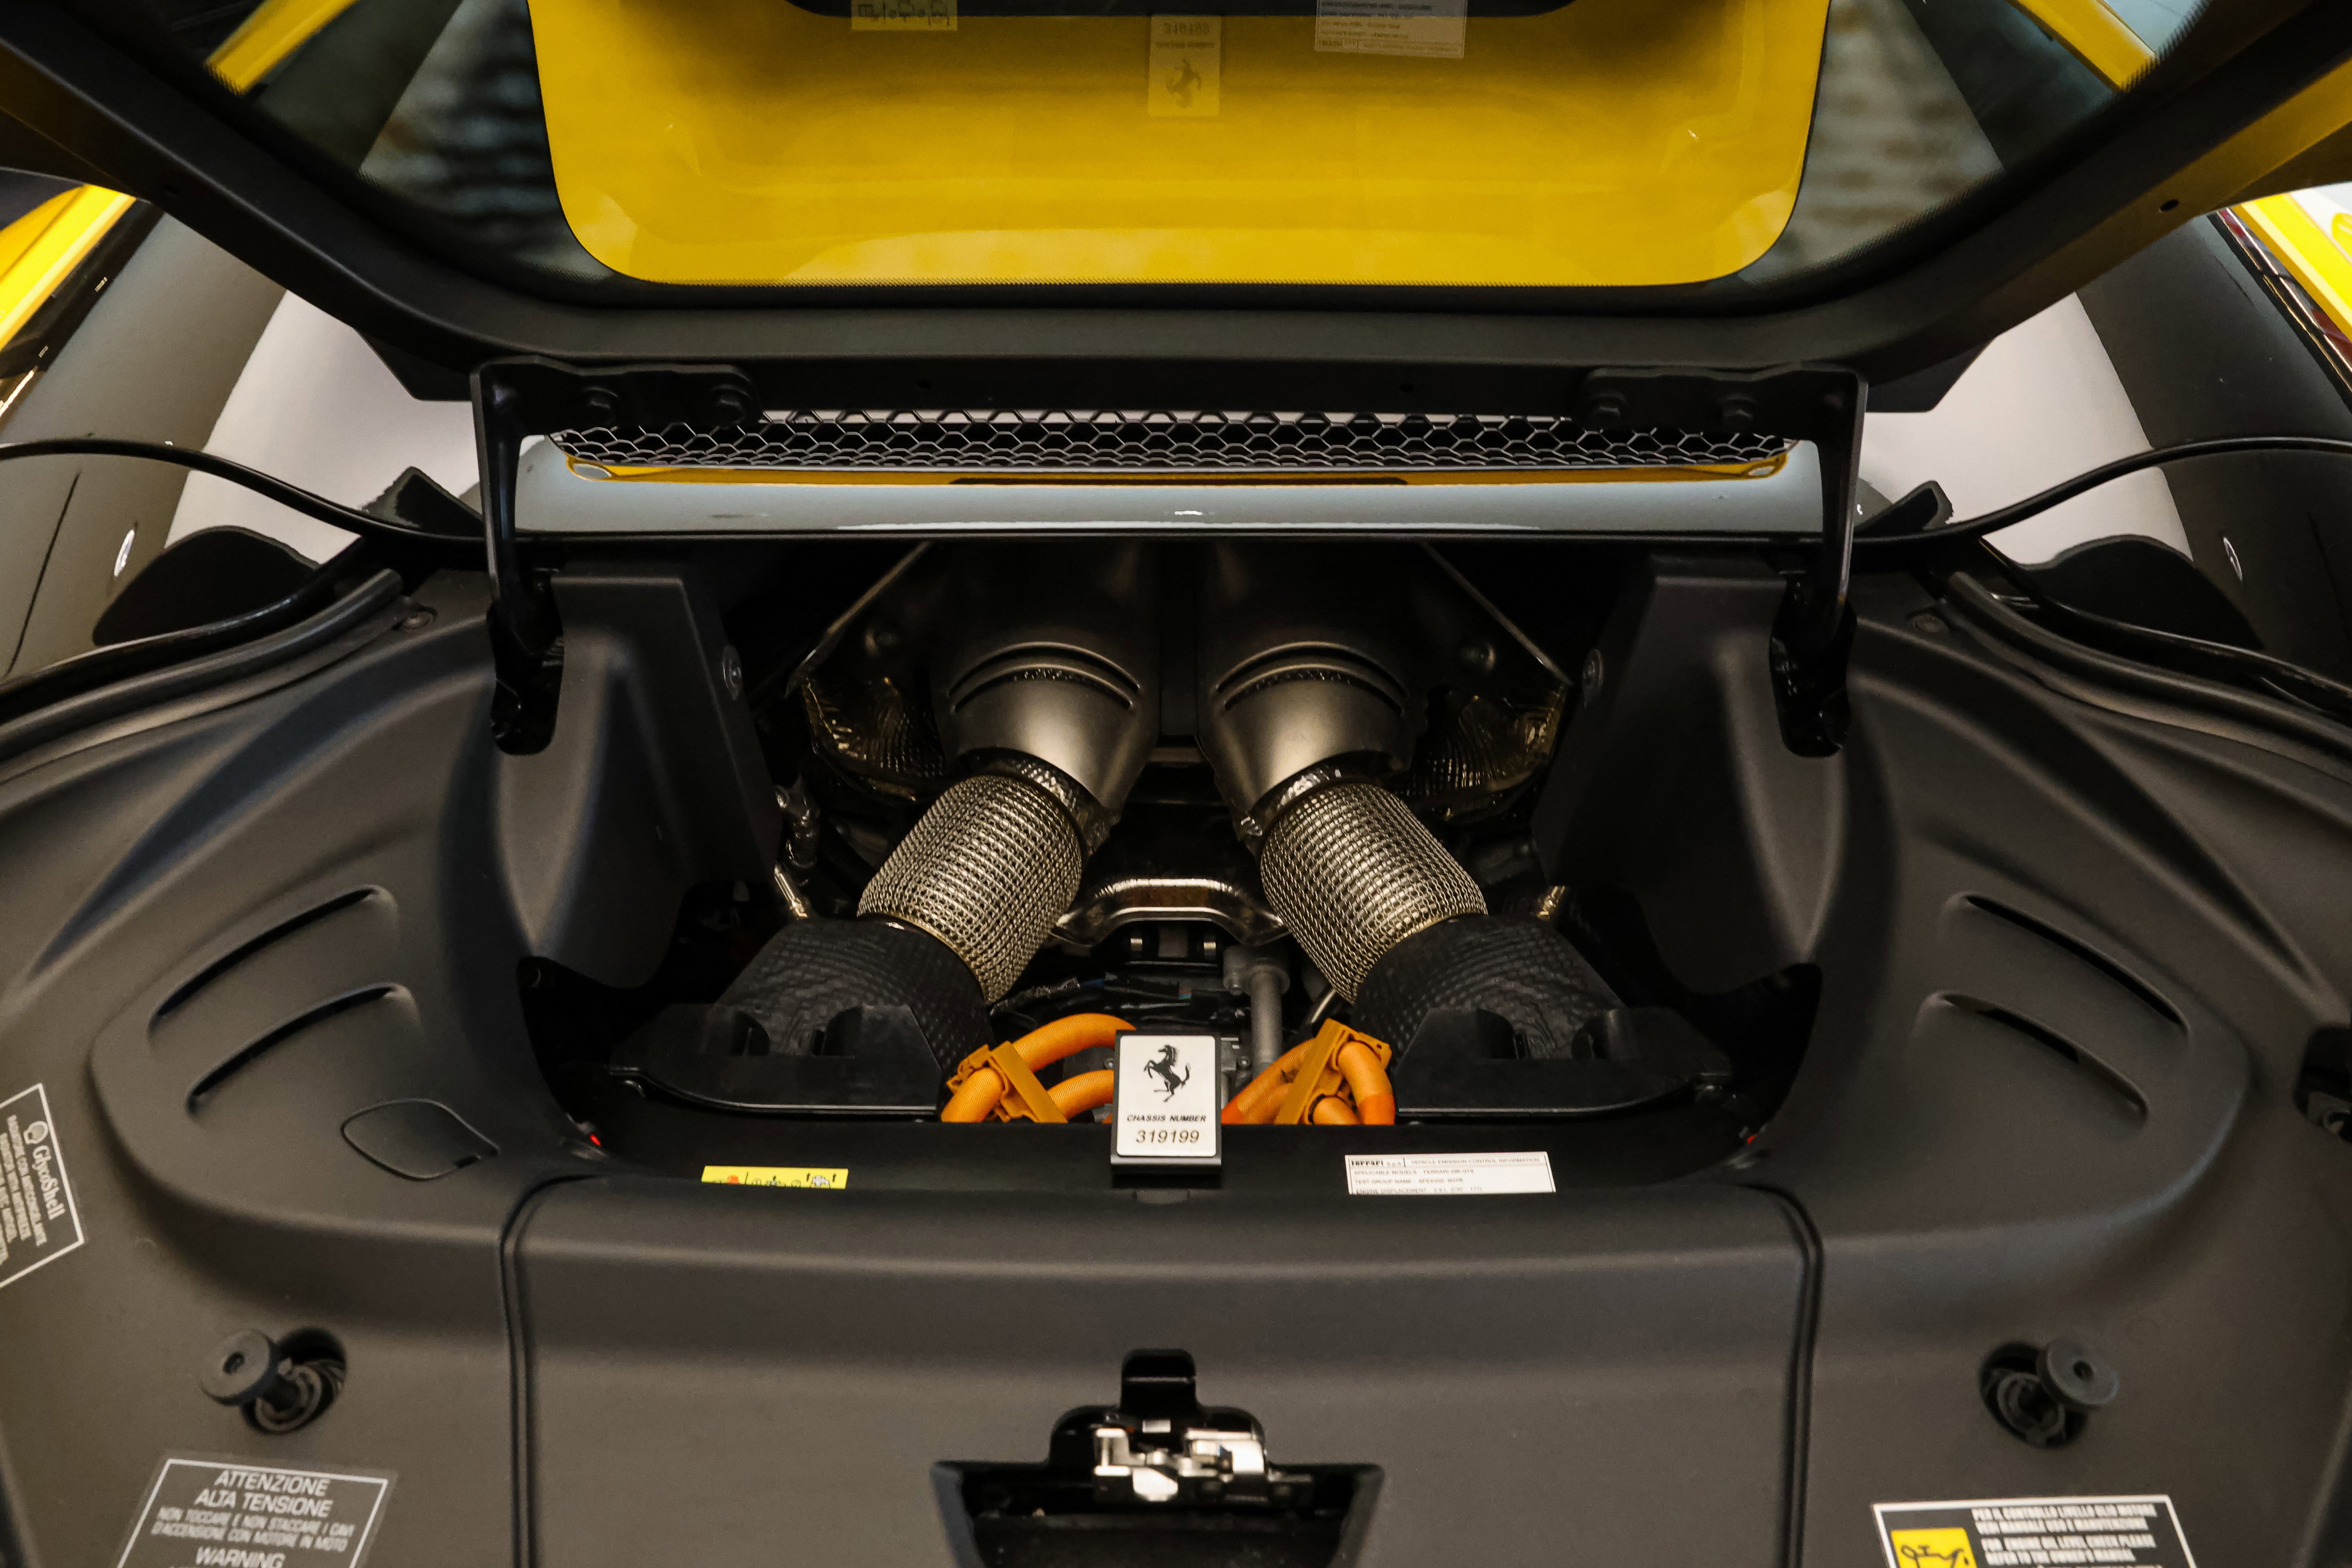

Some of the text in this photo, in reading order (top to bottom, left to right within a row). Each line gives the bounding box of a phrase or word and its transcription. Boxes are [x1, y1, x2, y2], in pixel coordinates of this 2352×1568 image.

[1169, 1114, 1206, 1122] NUMBER
[1136, 1129, 1199, 1143] 319199
[32, 1145, 66, 1220] GlycoShell
[214, 1470, 330, 1497] ATTENZIONE
[194, 1488, 334, 1518] ALTA TENSIONE
[195, 1546, 285, 1568] WARNING
